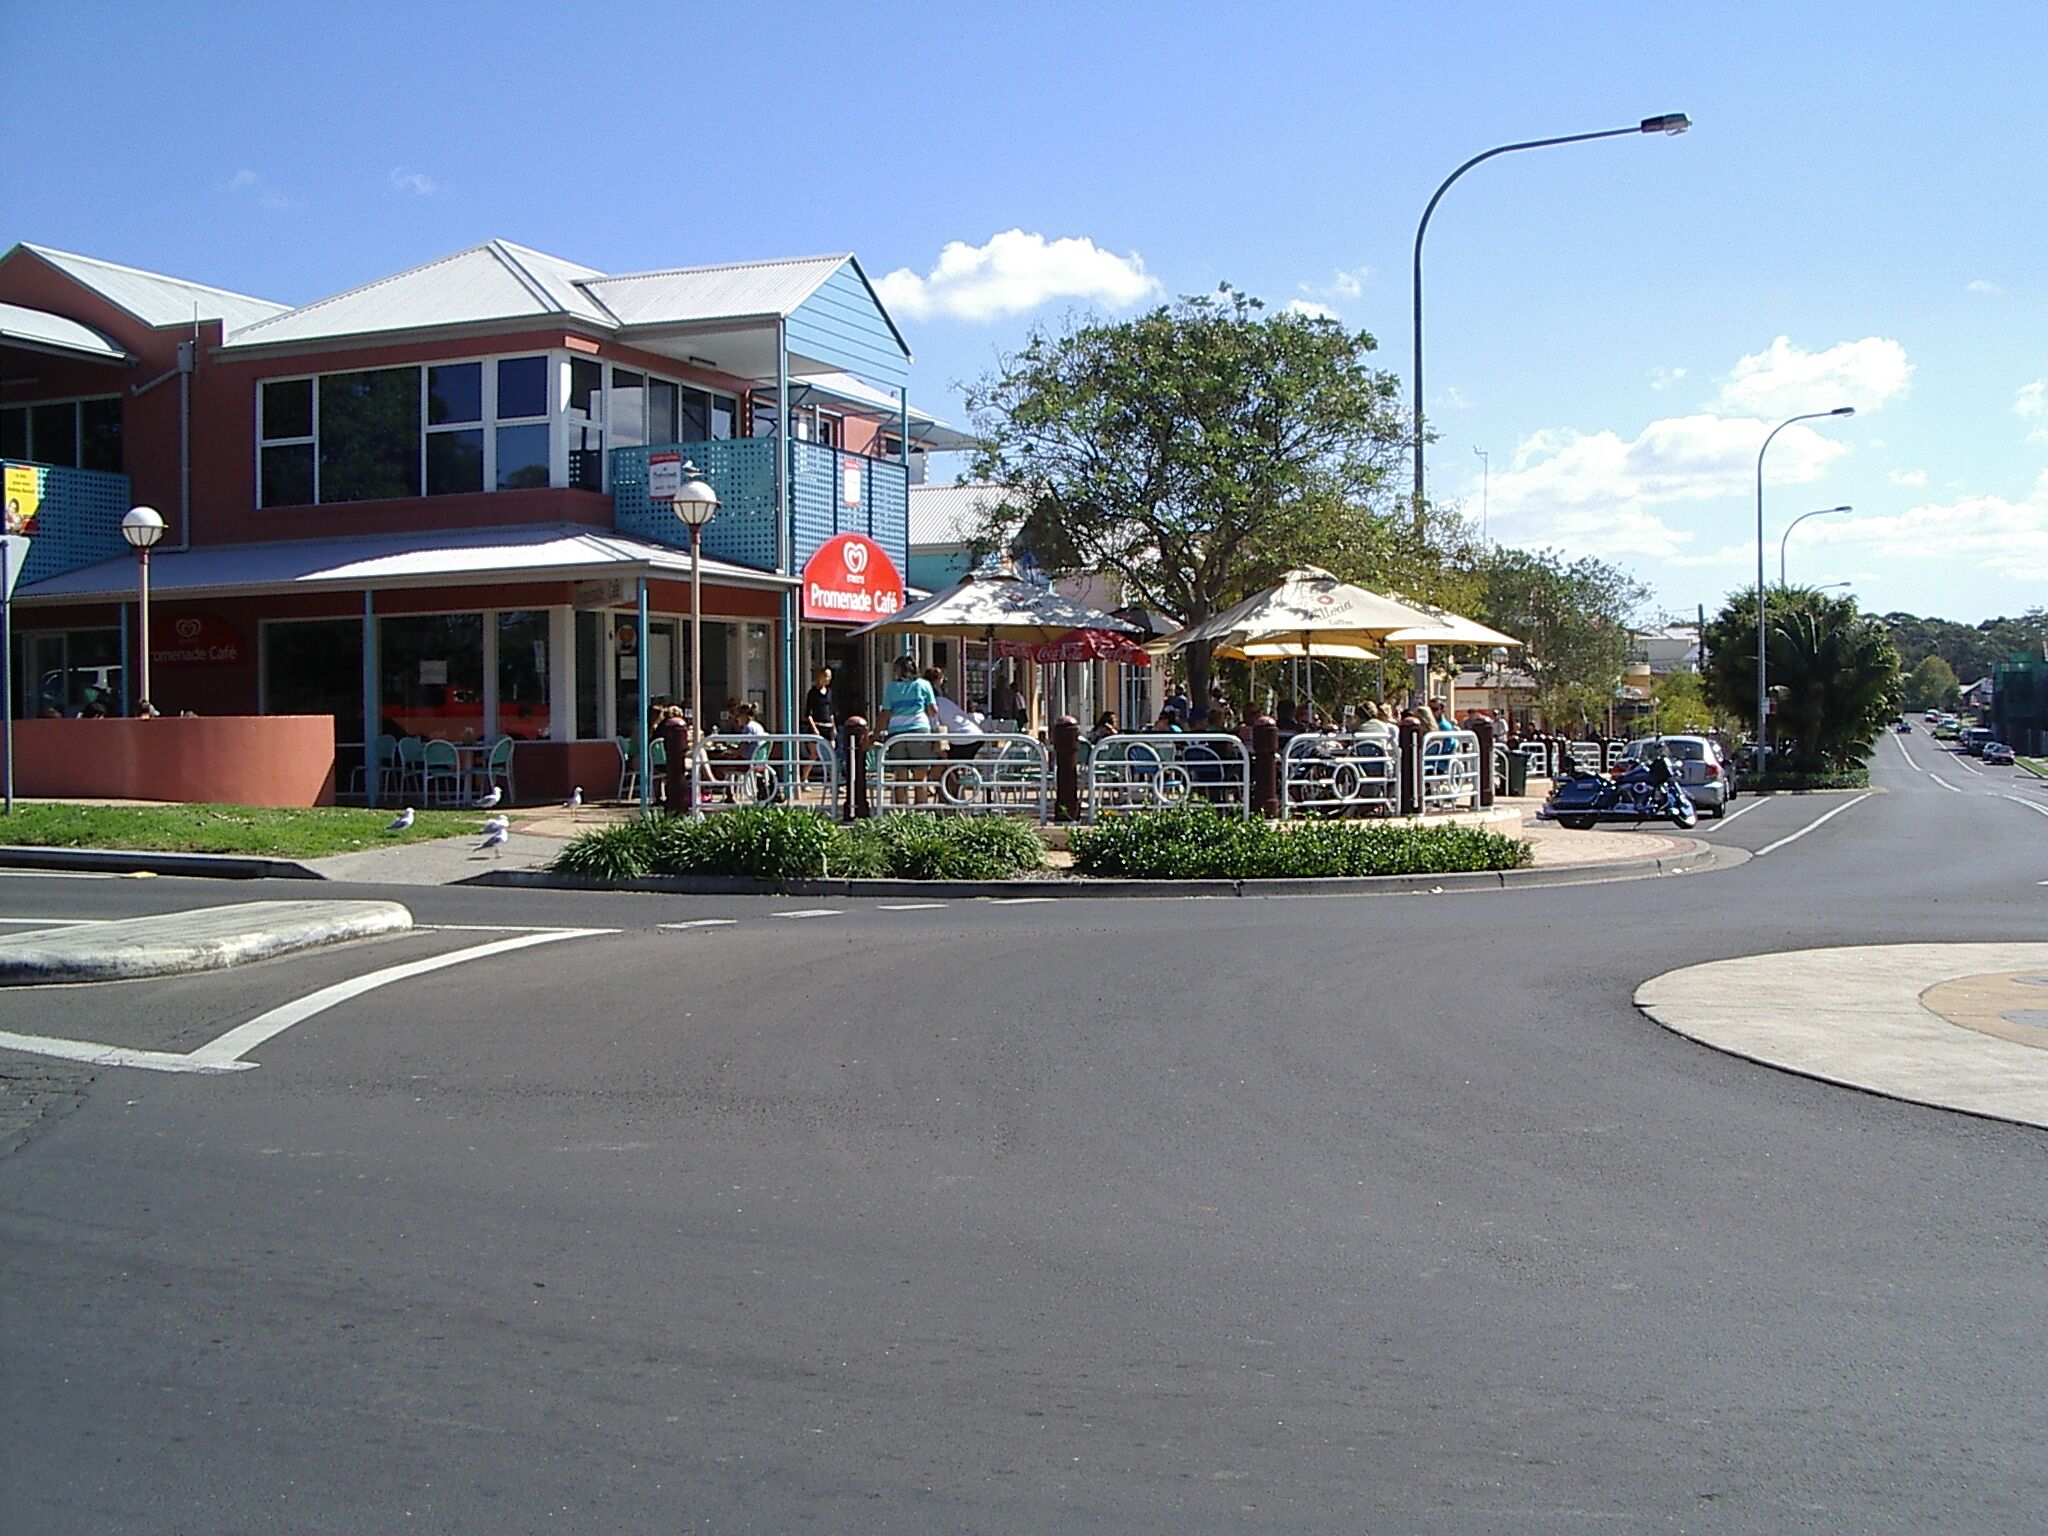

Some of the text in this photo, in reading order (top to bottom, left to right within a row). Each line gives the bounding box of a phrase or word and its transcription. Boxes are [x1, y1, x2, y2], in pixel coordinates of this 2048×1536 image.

[812, 584, 897, 613] Promenade Café
[209, 645, 237, 661] Café
